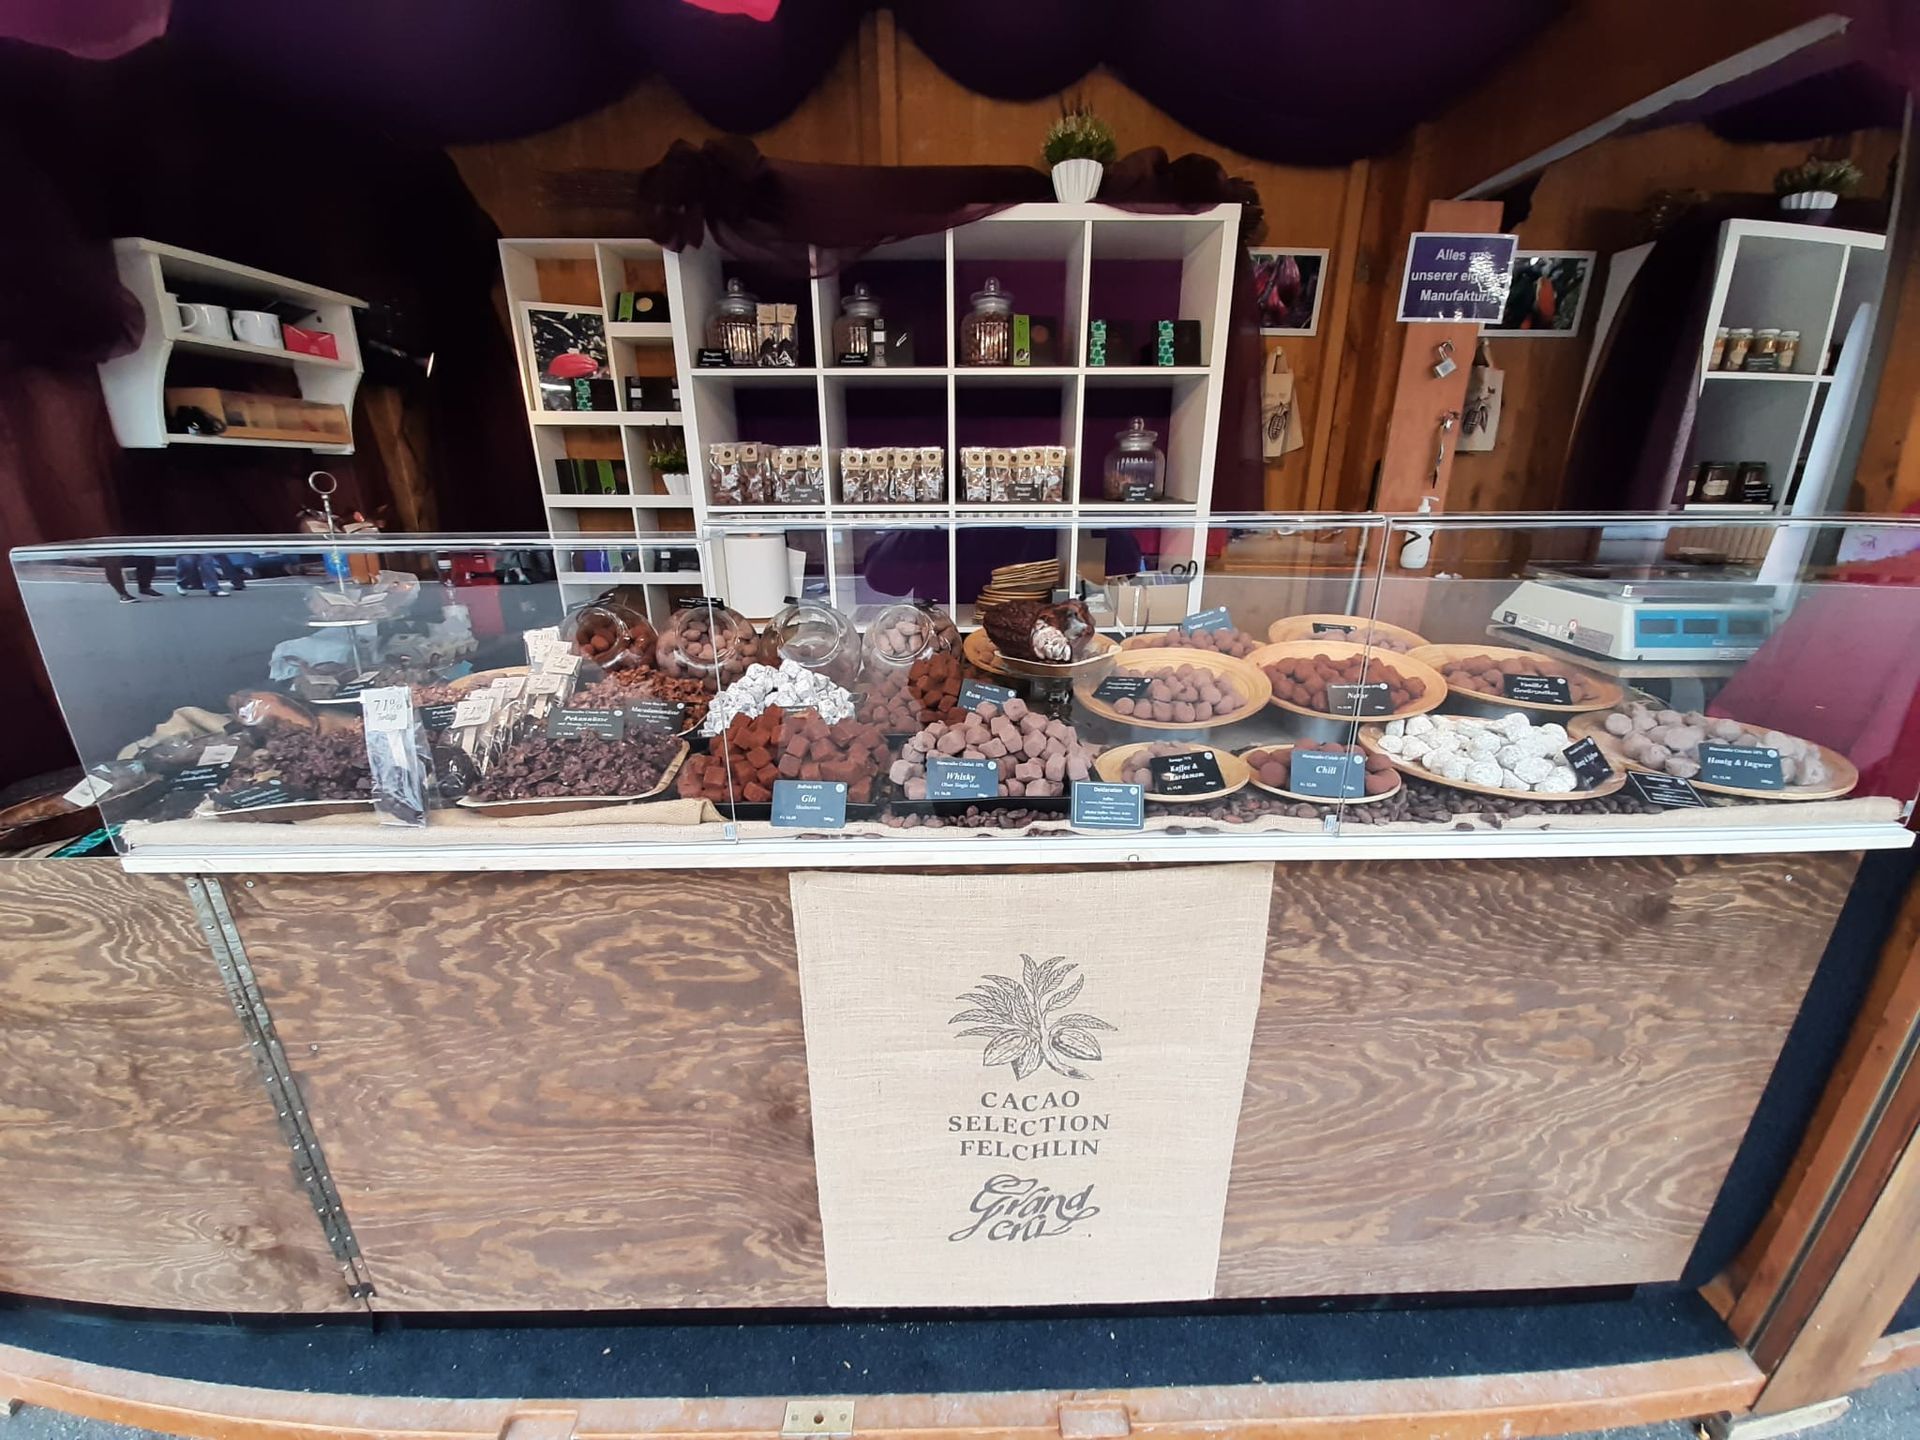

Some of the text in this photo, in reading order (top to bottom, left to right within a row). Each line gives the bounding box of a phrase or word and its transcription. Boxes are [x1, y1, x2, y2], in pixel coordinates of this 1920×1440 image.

[1435, 248, 1467, 261] Alles
[1411, 271, 1458, 281] unserer
[1707, 756, 1733, 767] Honig
[1743, 760, 1773, 769] Ingwer
[946, 772, 976, 783] Whisky
[801, 794, 817, 803] Gin
[980, 1090, 1080, 1112] CACAO
[948, 1113, 1111, 1137] SELECTION
[959, 1138, 1101, 1162] FELCHLIN
[947, 1173, 1101, 1242] Grand
